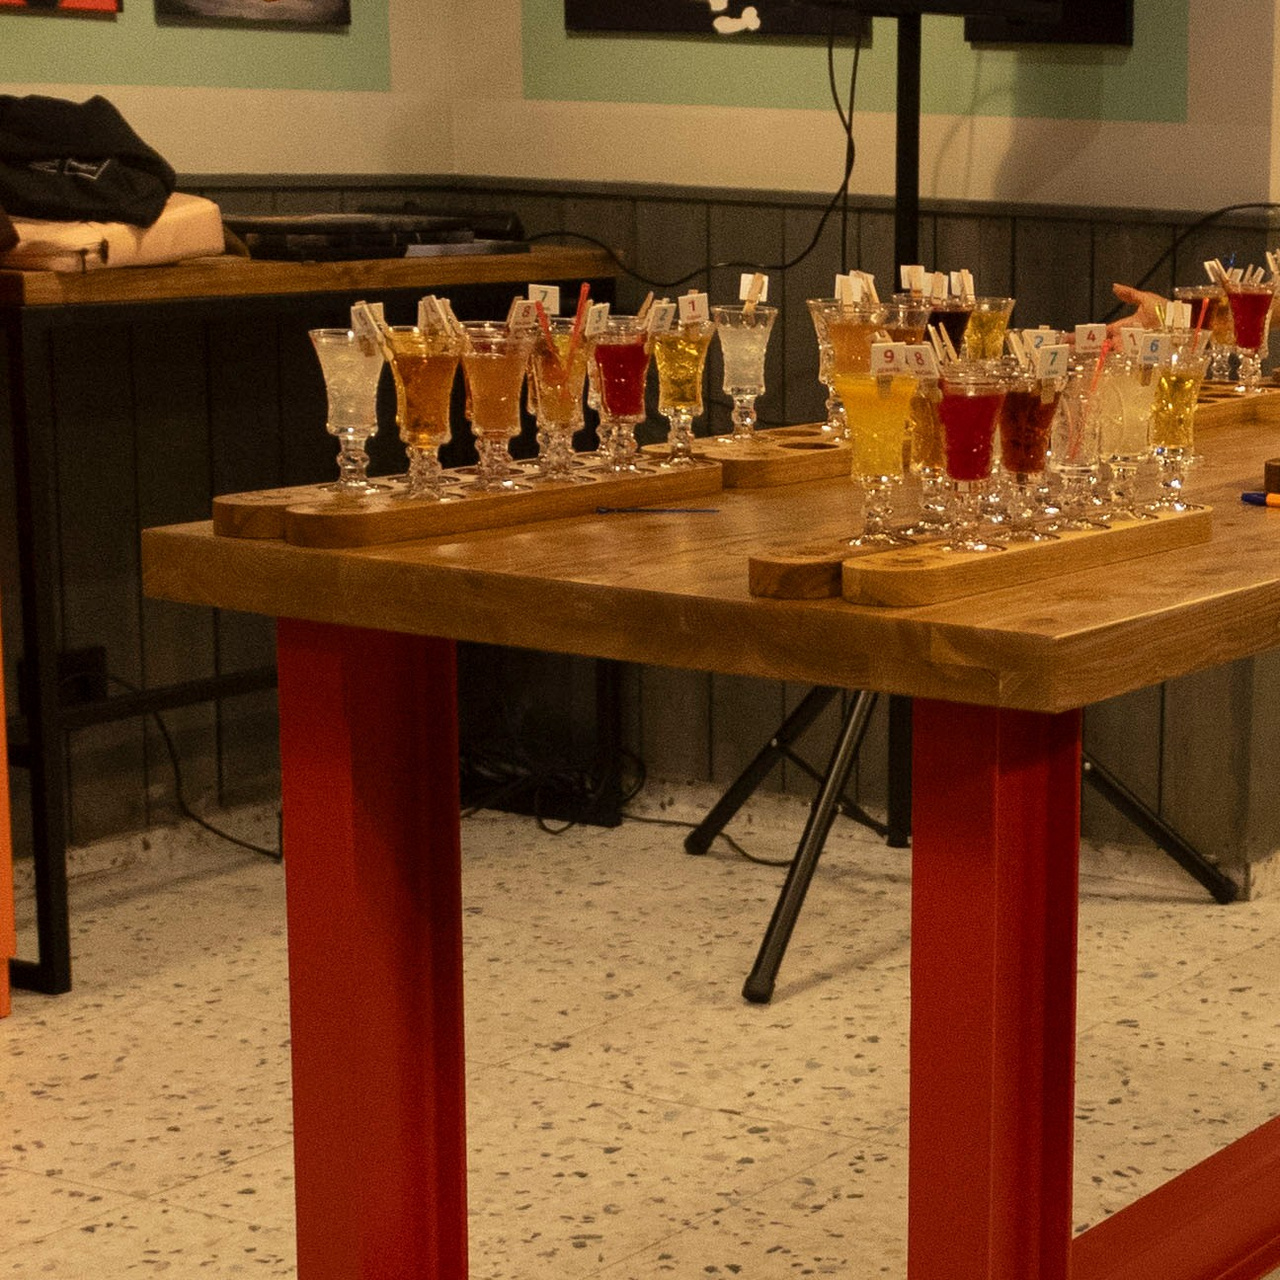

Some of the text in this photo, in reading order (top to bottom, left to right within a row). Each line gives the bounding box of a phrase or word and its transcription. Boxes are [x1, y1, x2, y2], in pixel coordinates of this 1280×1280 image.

[1087, 330, 1096, 342] 4
[884, 349, 895, 363] 9
[914, 351, 925, 365] 8
[1050, 351, 1058, 366] 7
